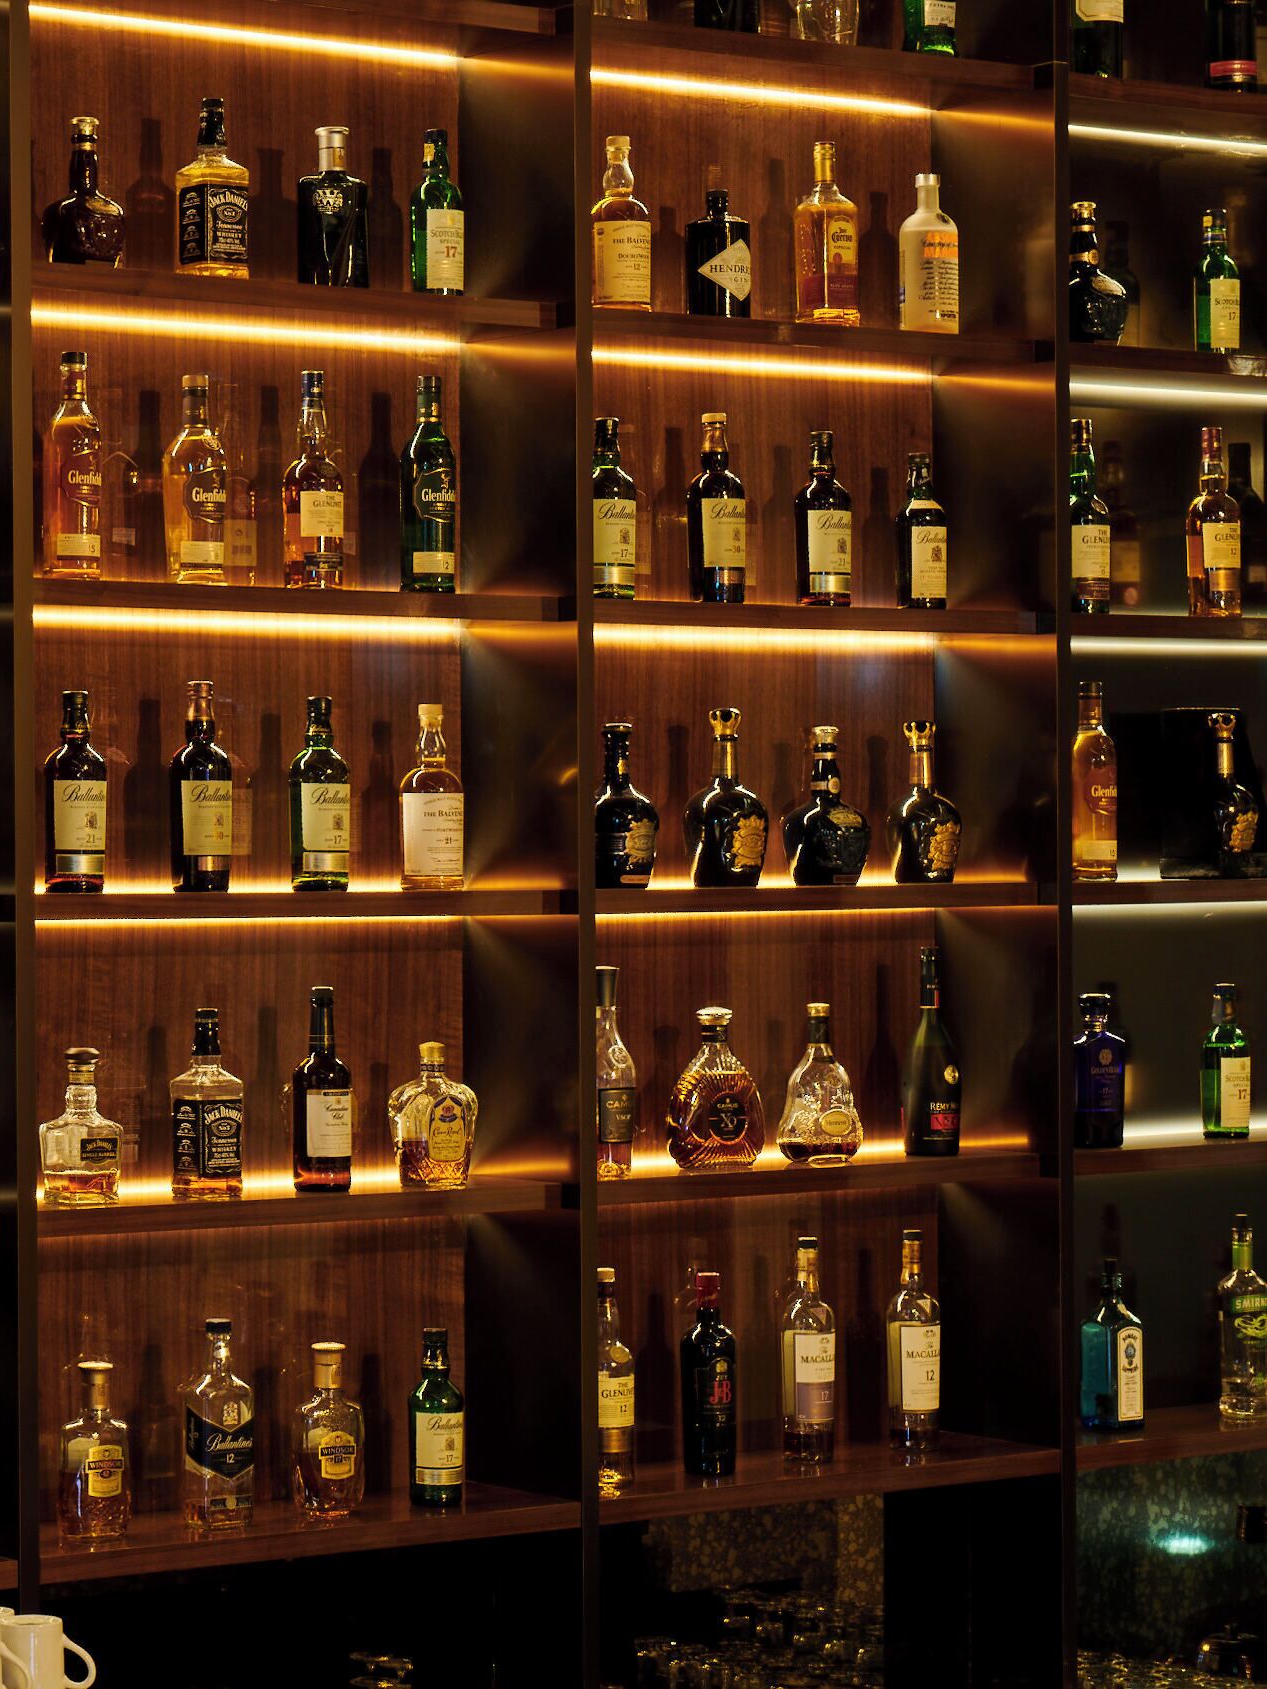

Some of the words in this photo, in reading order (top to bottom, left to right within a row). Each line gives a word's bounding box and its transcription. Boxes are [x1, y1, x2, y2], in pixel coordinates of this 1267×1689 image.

[208, 193, 226, 209] JACK
[831, 231, 852, 244] Cuervo
[444, 245, 458, 258] 17
[1228, 311, 1237, 321] 17
[620, 548, 629, 558] 17
[732, 544, 741, 554] 30
[837, 557, 846, 567] 21
[85, 833, 96, 844] 21
[333, 835, 342, 845] 17
[444, 836, 453, 845] 21
[1237, 1088, 1248, 1100] 17
[204, 1109, 221, 1125] JACK
[925, 1369, 935, 1382] 12
[619, 1404, 627, 1413] 12
[321, 1446, 355, 1456] WINDSOR
[226, 1452, 235, 1464] 12
[445, 1454, 454, 1463] 17
